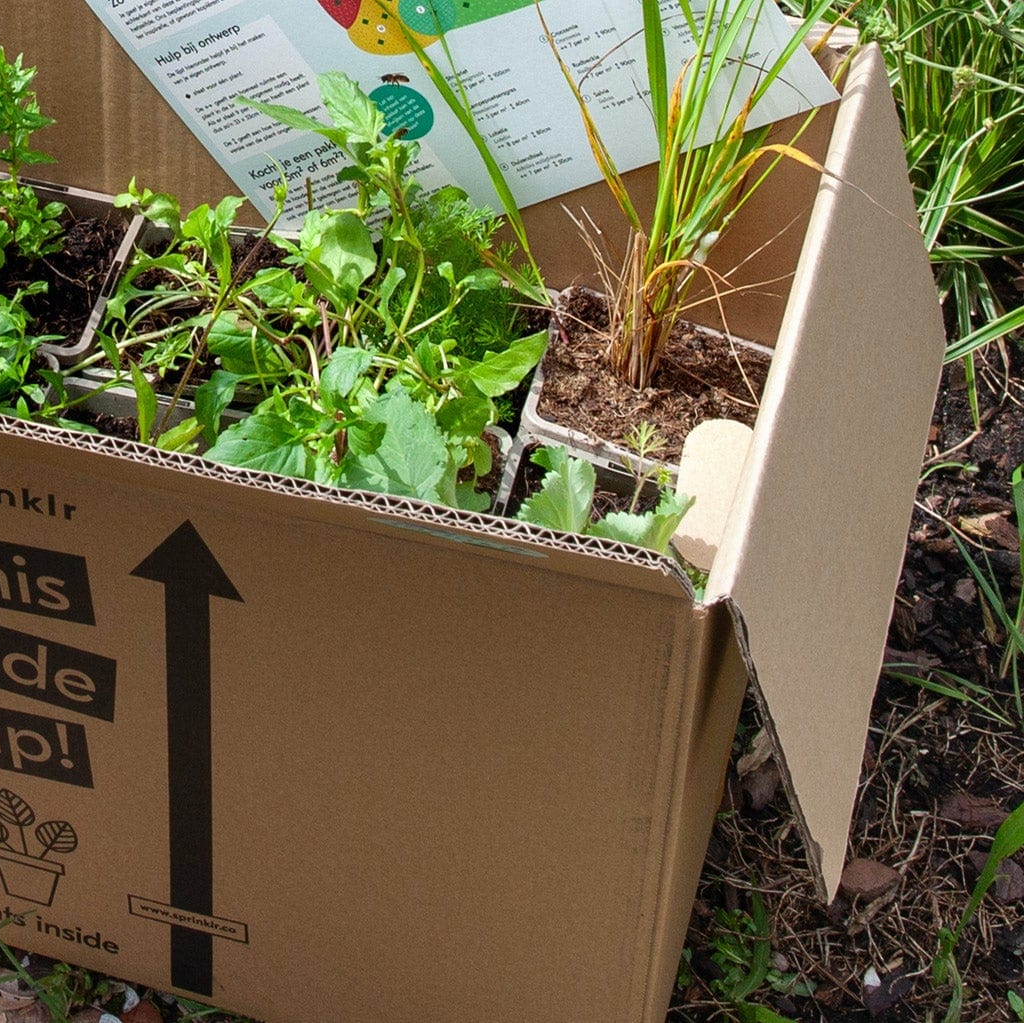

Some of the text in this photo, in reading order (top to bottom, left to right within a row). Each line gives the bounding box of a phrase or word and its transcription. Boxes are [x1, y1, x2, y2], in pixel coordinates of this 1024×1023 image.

[153, 24, 241, 67] Hulp bij ontwerp
[258, 177, 284, 191] voor
[283, 165, 304, 182] 5m²
[306, 160, 319, 173] of
[319, 150, 347, 168] 6m²?
[277, 158, 292, 171] je
[292, 150, 314, 164] een
[36, 915, 120, 955] inside
[139, 904, 237, 934] www.sprinklr.co
